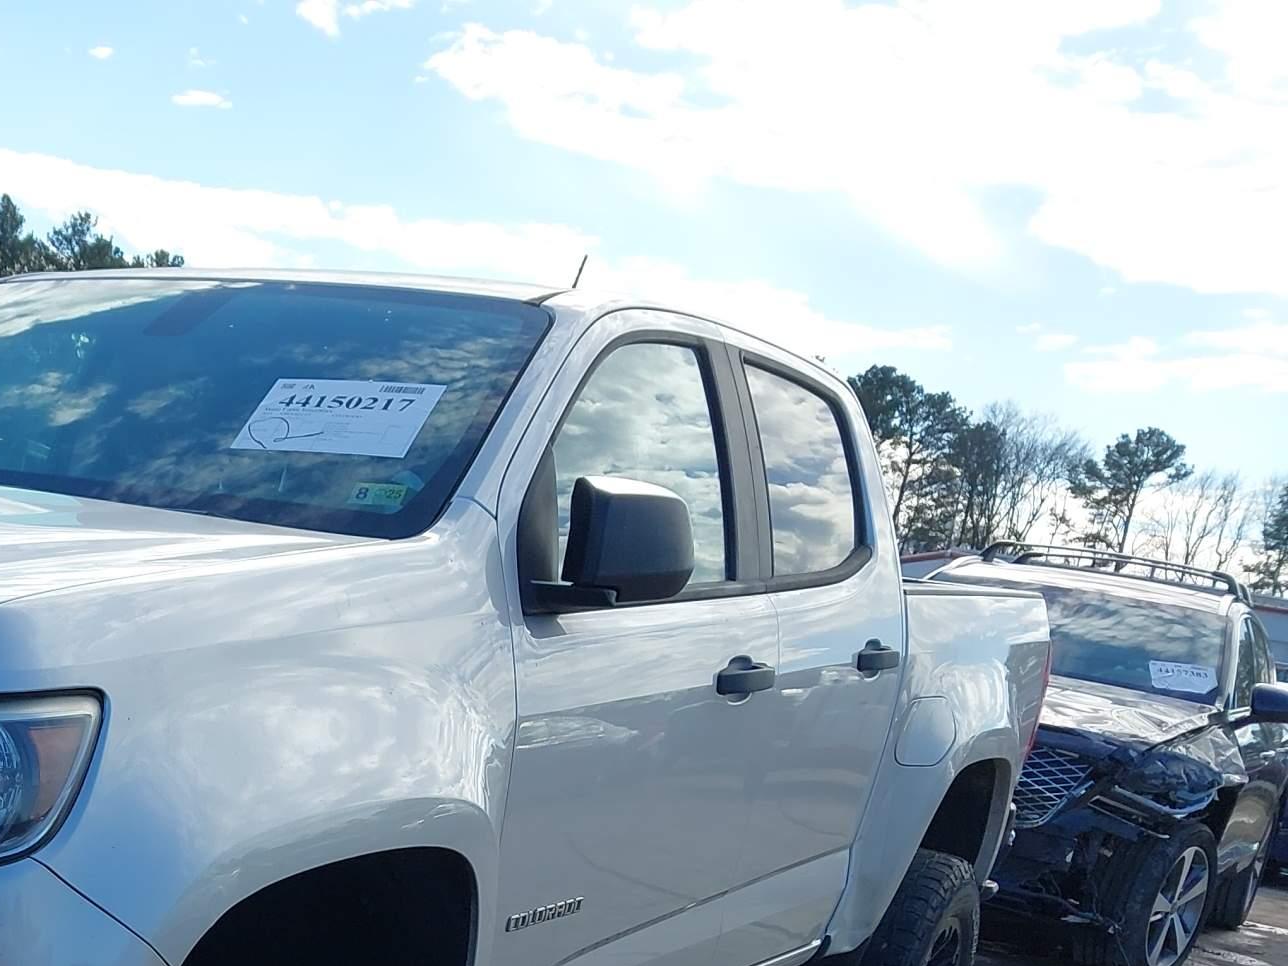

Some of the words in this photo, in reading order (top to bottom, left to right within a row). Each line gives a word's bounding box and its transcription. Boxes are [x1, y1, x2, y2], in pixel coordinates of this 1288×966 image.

[279, 393, 415, 412] 44150217
[355, 487, 369, 500] 8
[505, 896, 584, 932] COLORADO
